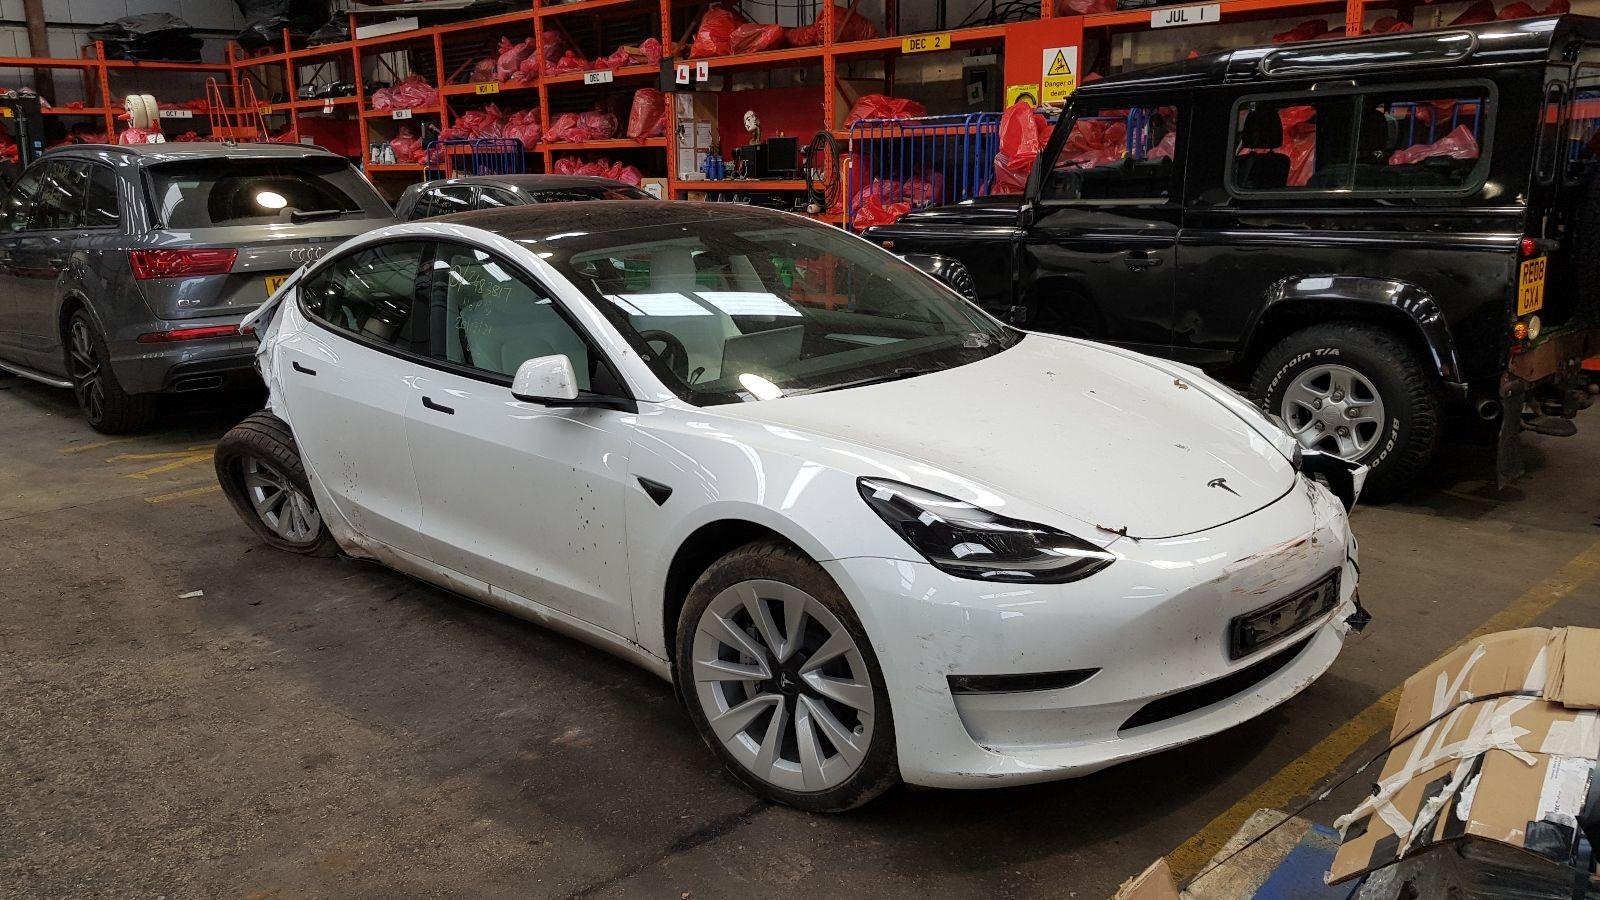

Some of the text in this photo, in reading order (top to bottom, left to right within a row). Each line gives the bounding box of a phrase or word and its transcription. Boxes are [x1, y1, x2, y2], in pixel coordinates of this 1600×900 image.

[1165, 9, 1188, 23] JUL
[910, 36, 941, 50] DEC 2
[590, 73, 600, 82] DEC
[680, 68, 686, 80] L
[699, 66, 705, 77] L
[1044, 80, 1066, 88] Danger
[1523, 260, 1544, 285] RE08
[1524, 286, 1539, 309] GXA
[1315, 347, 1340, 356] T/A
